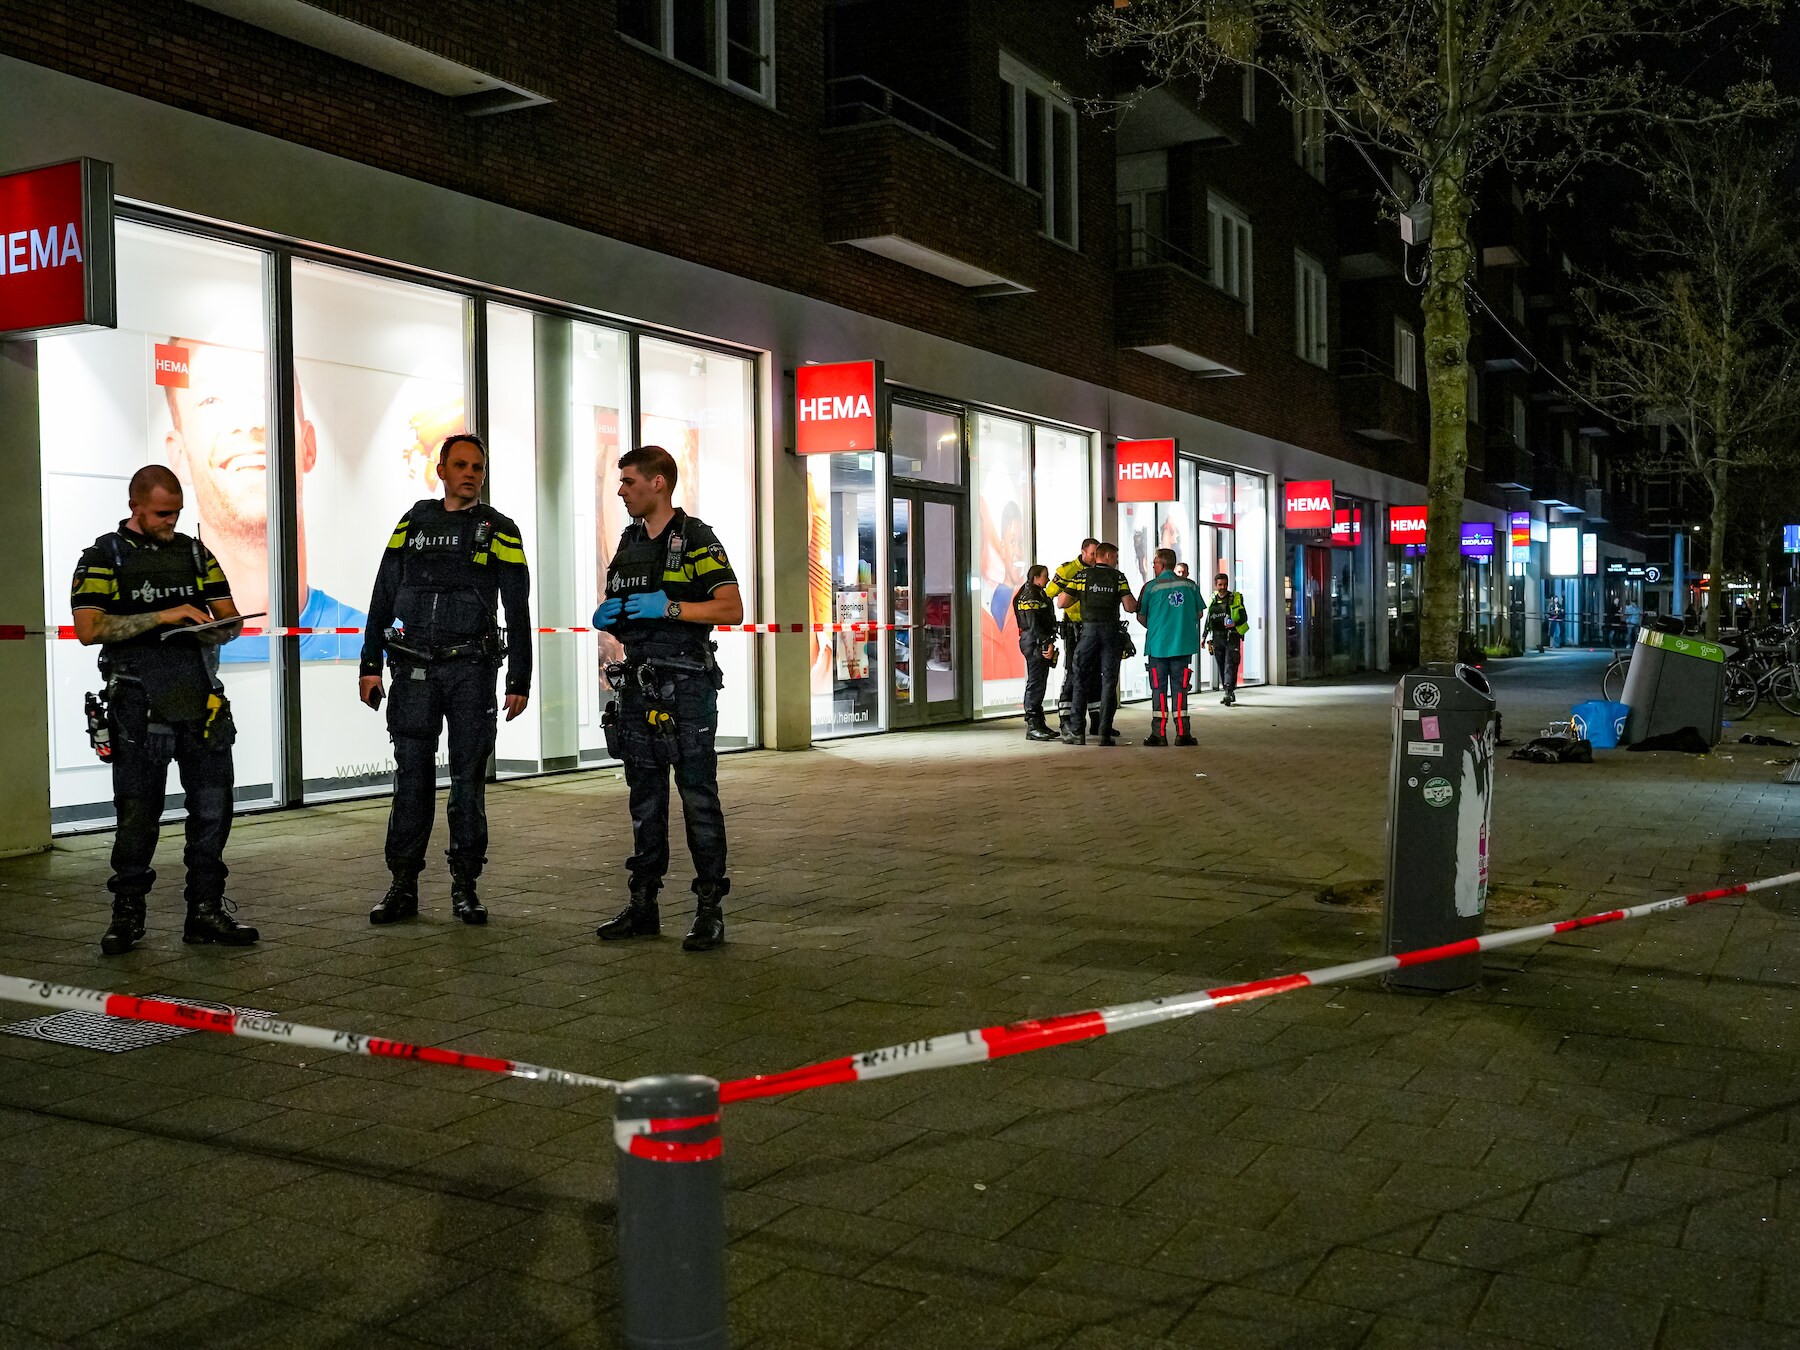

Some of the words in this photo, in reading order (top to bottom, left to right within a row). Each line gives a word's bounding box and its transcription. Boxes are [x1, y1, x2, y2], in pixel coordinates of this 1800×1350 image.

[0, 222, 83, 276] EMA
[156, 358, 189, 375] HEMA
[799, 394, 872, 422] HEMA
[598, 424, 617, 434] HEMA
[1118, 461, 1173, 482] HEMA
[1287, 497, 1331, 512] HEMA
[1390, 519, 1427, 531] HEMA
[408, 530, 459, 550] POLITIE
[131, 579, 195, 603] POLITIE
[1089, 583, 1114, 592] POLITIE
[840, 602, 864, 613] openings
[211, 1013, 296, 1037] BETREDEN
